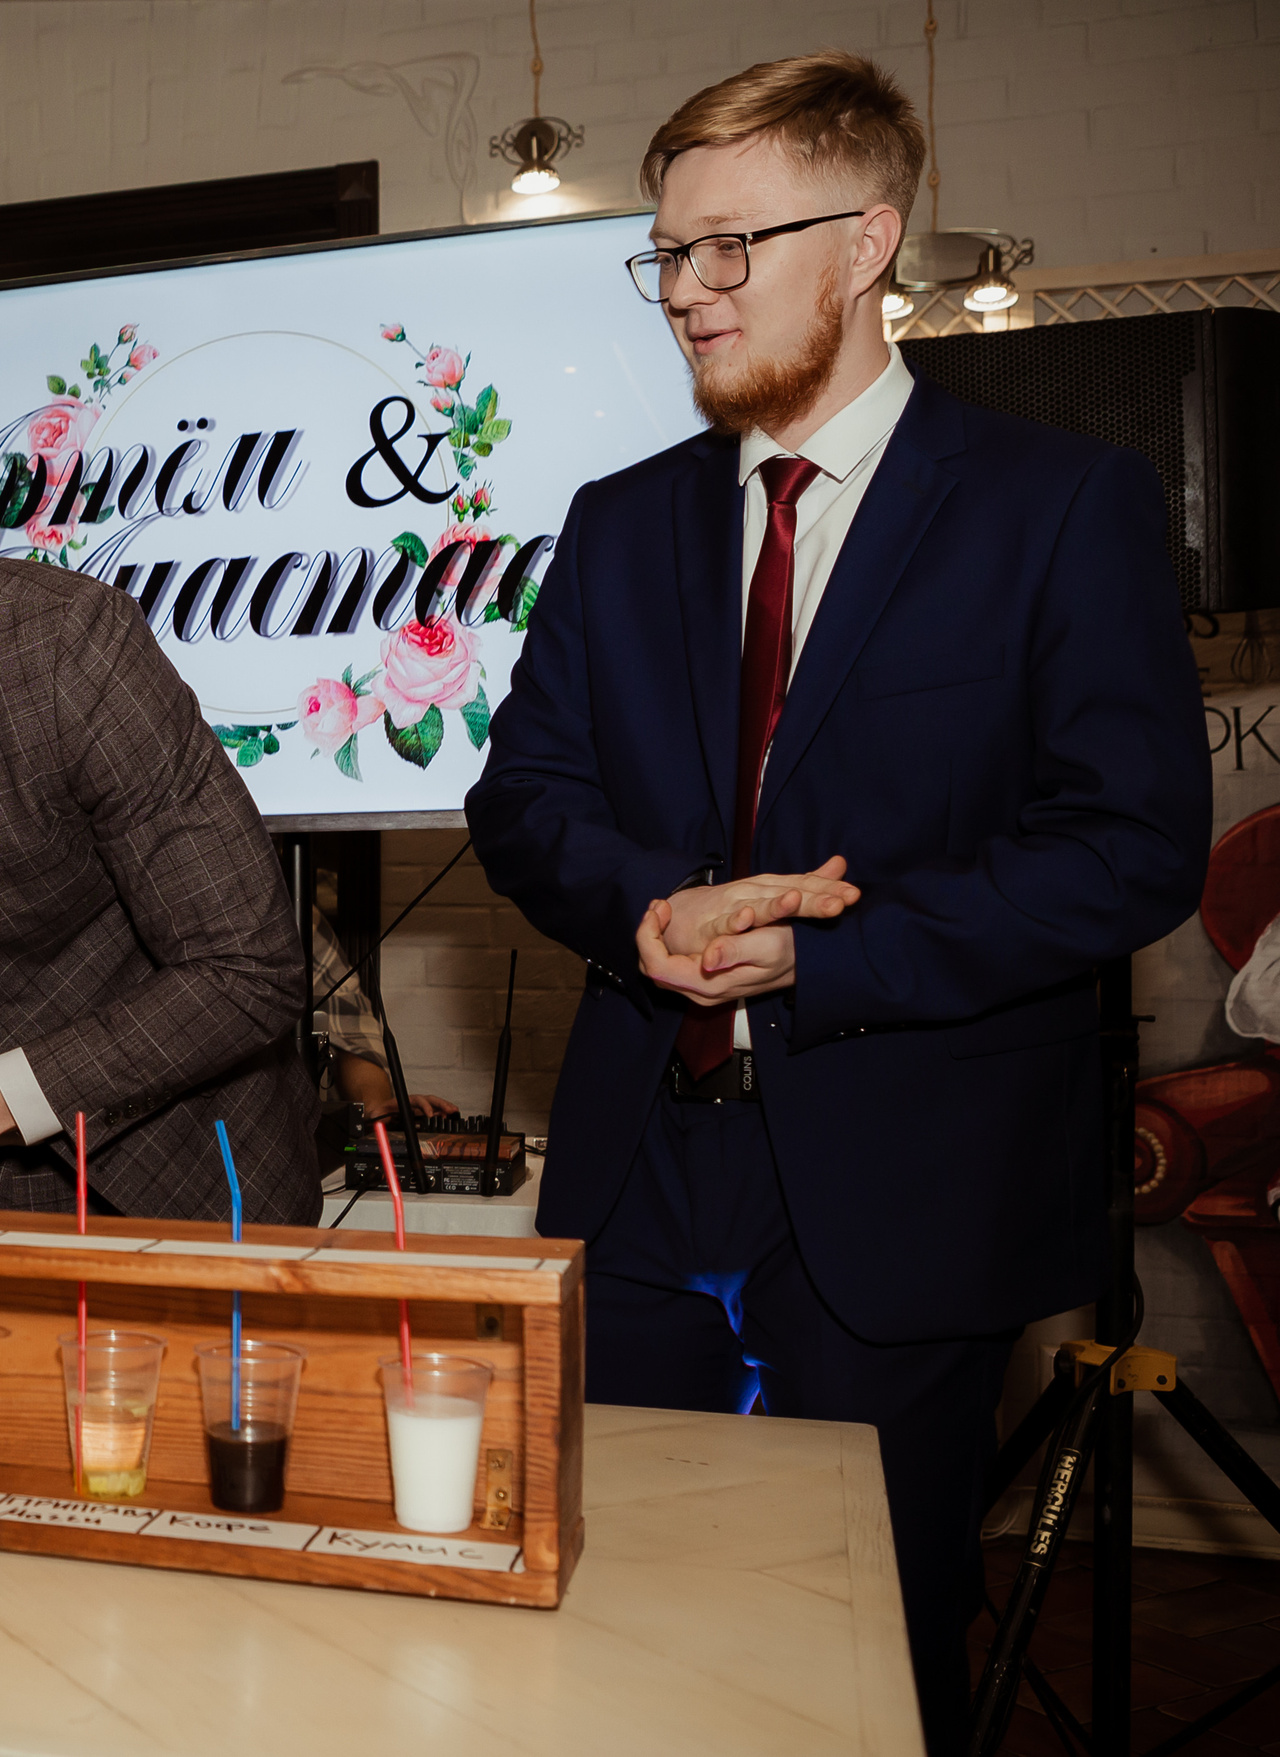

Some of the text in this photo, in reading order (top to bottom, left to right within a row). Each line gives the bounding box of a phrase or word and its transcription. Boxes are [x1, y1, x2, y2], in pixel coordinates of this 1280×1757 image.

[346, 395, 460, 508] &
[327, 1530, 484, 1560] Кумыс
[1030, 1454, 1077, 1556] HERCULES
